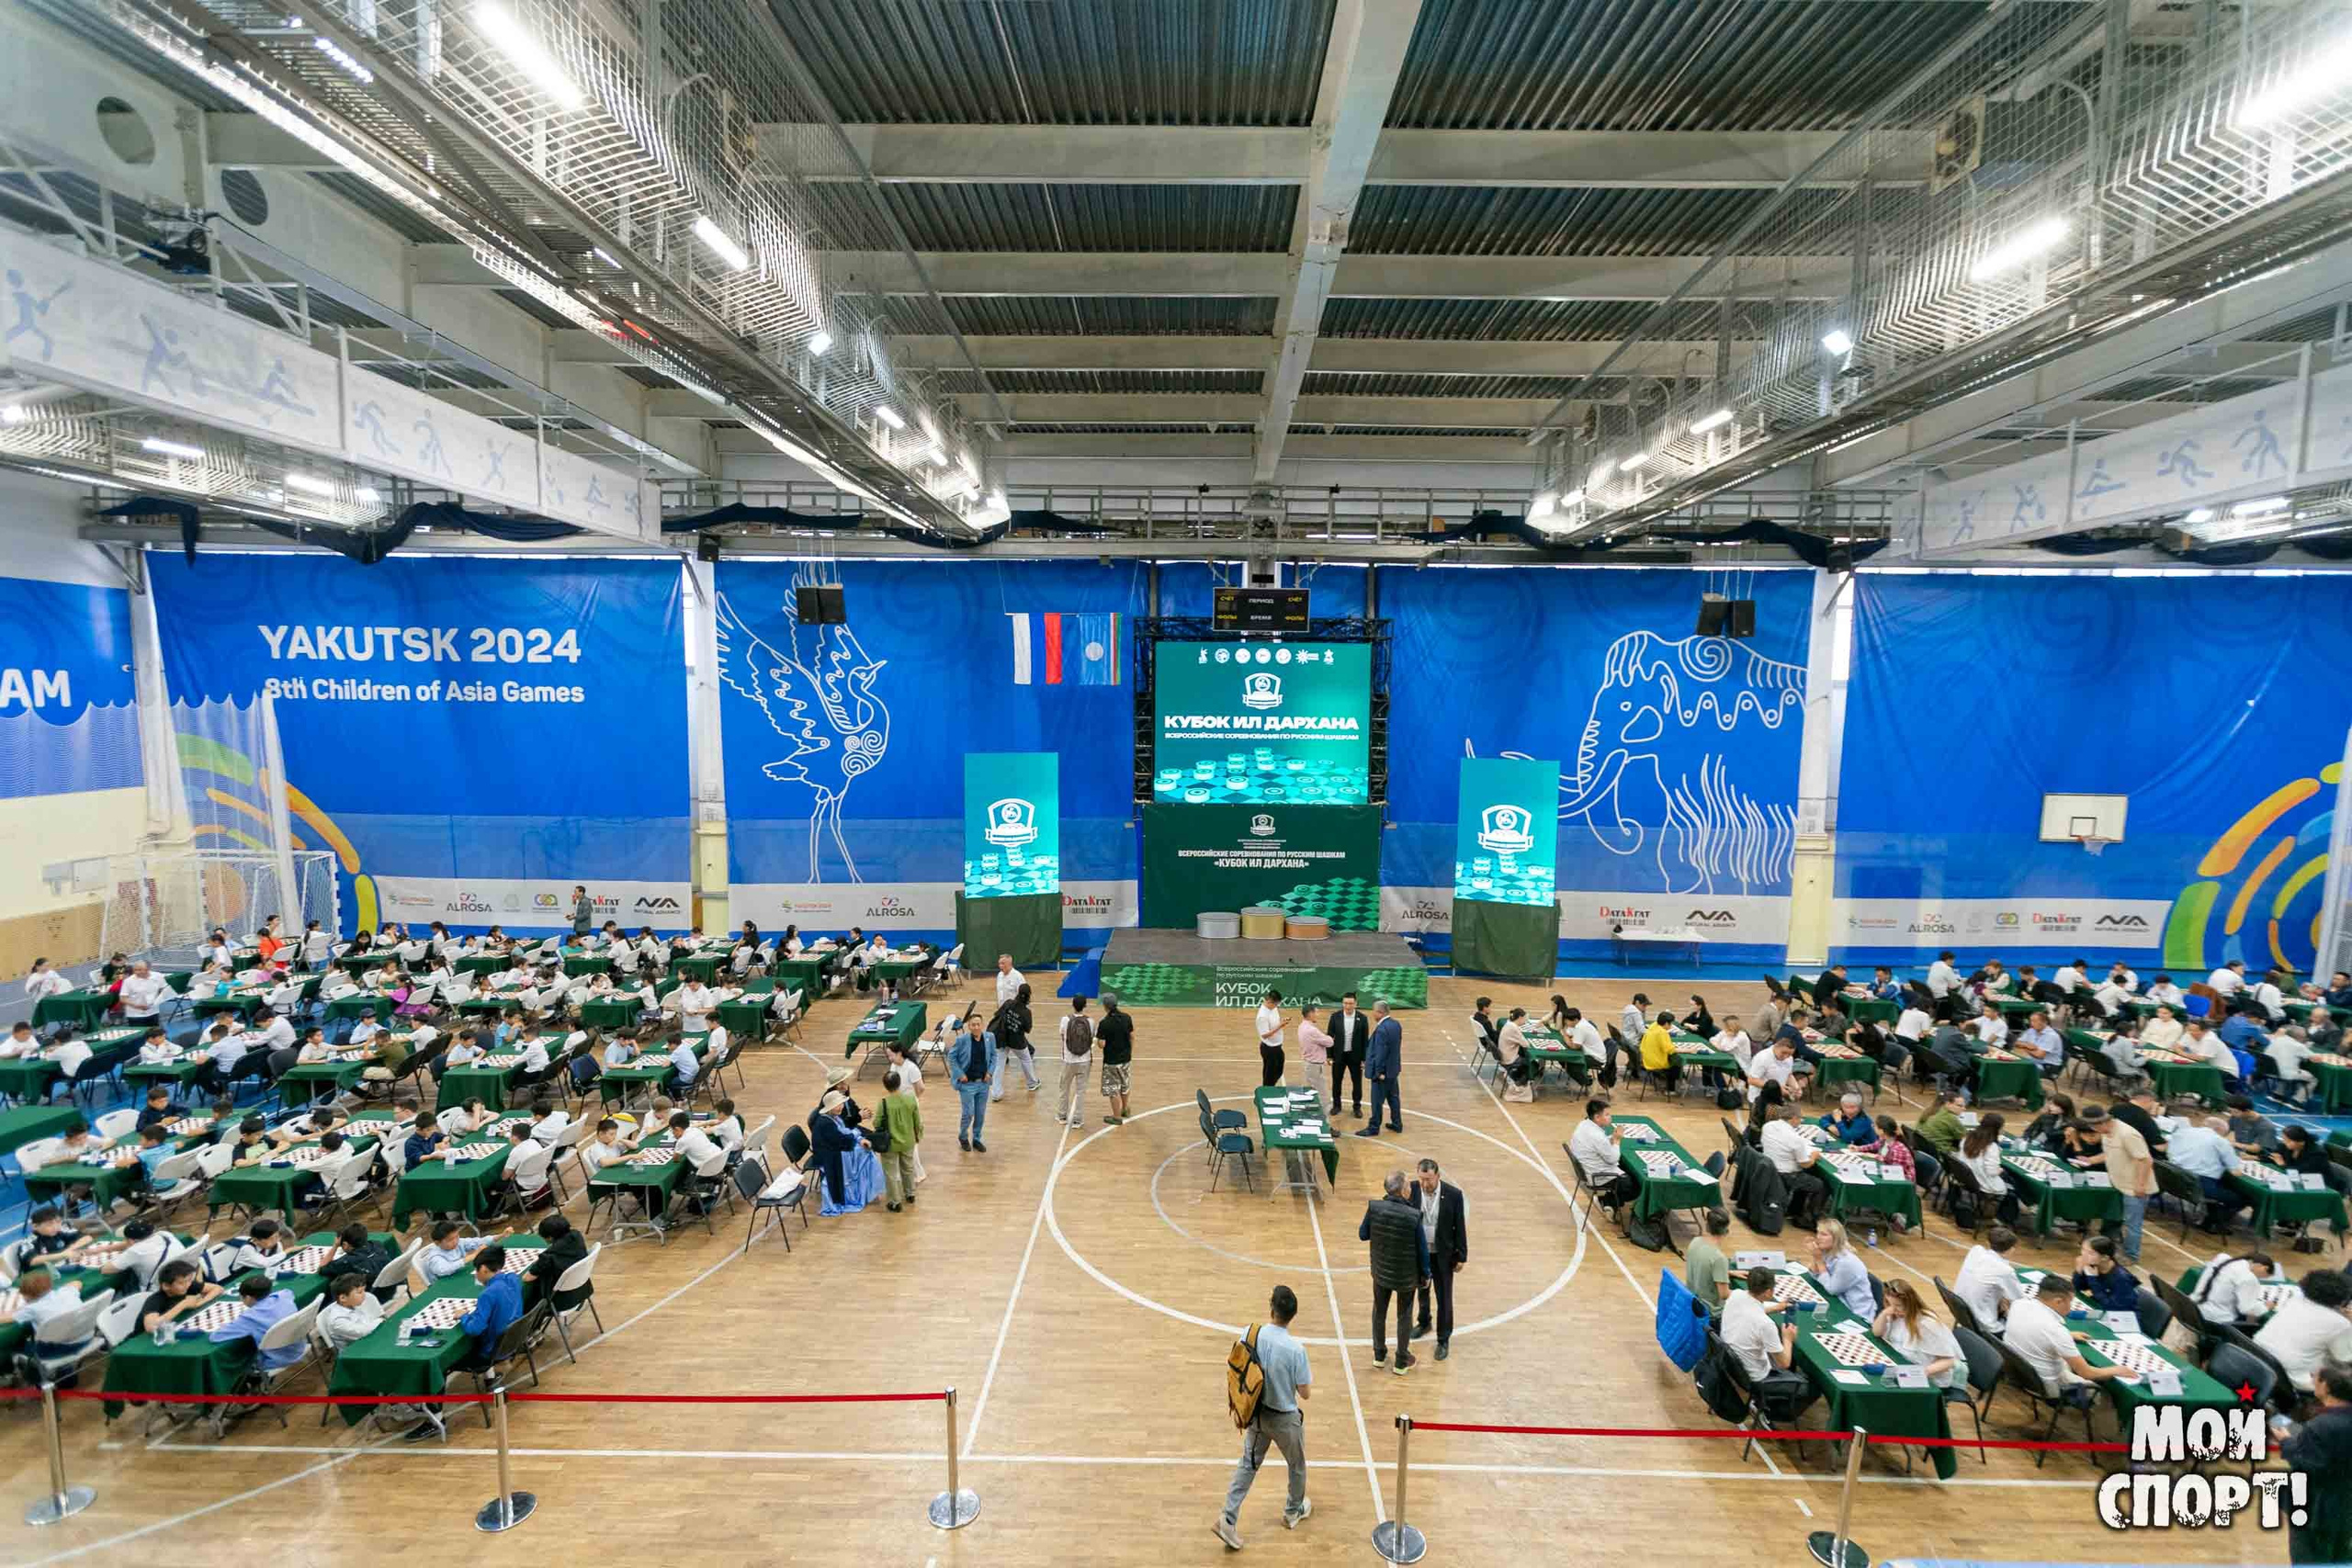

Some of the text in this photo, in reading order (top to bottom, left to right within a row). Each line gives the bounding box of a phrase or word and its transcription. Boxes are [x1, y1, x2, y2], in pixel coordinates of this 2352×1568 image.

[257, 626, 582, 663] YAKUTSK 2024
[265, 677, 585, 703] 8th Children of Asia Games
[1164, 716, 1360, 731] КУБОК ИЛ ДАРХАНА
[1178, 849, 1229, 857] ВСЕРОССИЙСКИЕ
[1214, 858, 1309, 869] «КУБОК ИЛ ДАРХАНА»
[447, 903, 492, 913] ALROSA
[865, 907, 915, 917] ALROSA
[1402, 909, 1449, 919] ALROSA
[1907, 923, 1955, 933] ALROSA
[1216, 982, 1272, 994] КУБОК
[1216, 996, 1239, 1007] ИЛ
